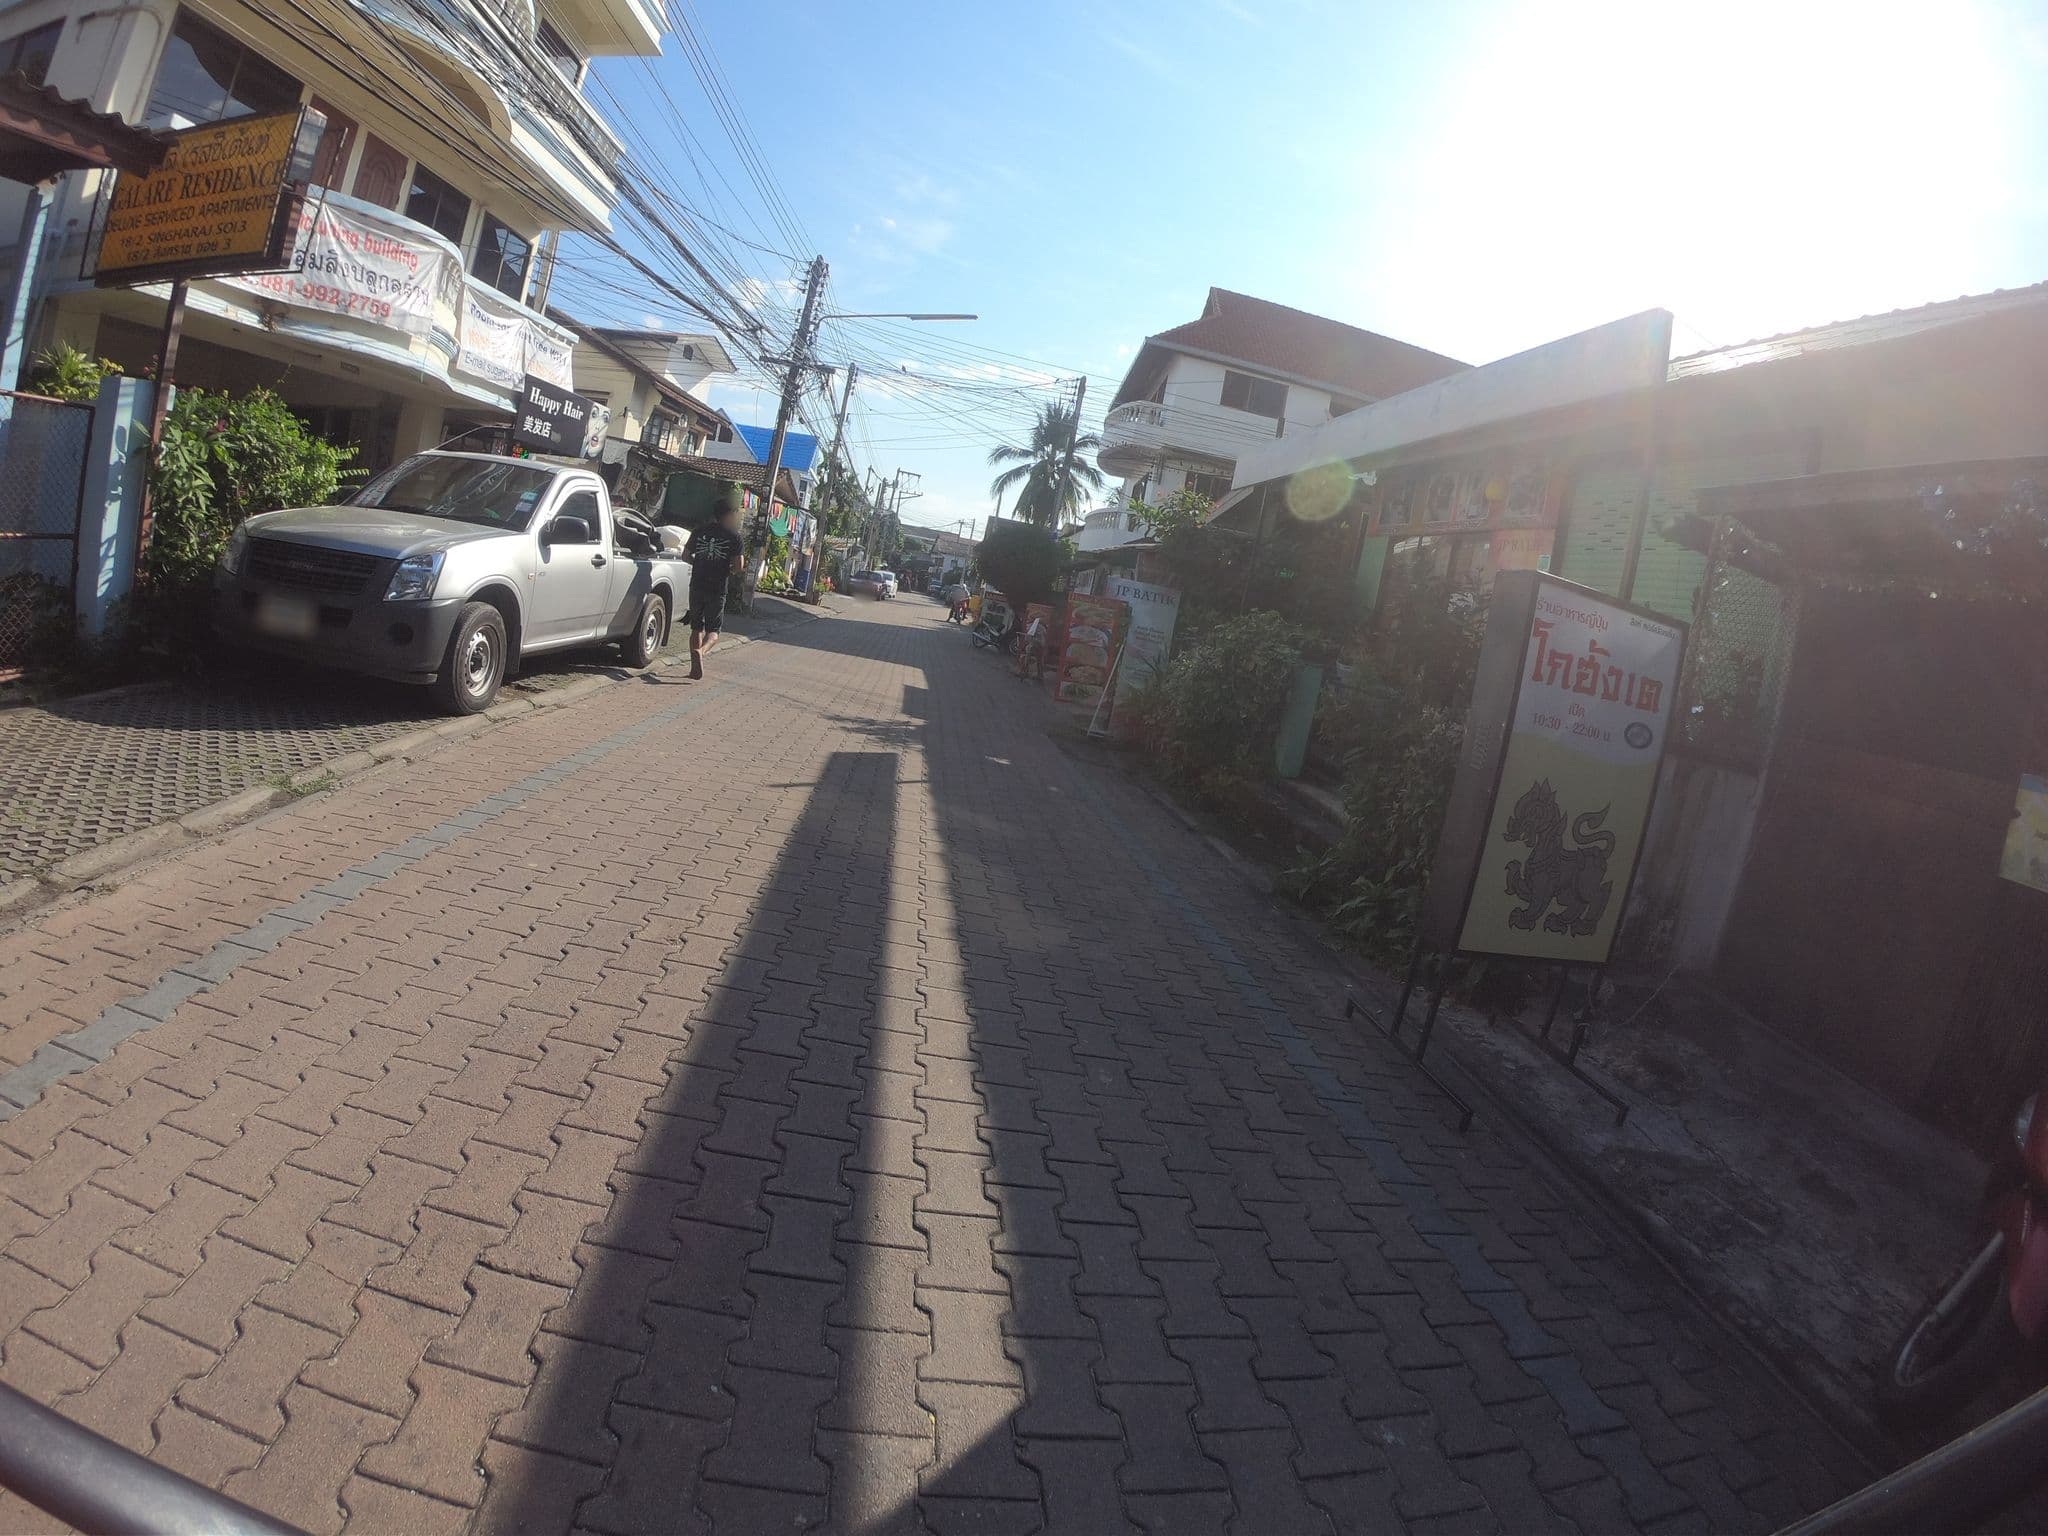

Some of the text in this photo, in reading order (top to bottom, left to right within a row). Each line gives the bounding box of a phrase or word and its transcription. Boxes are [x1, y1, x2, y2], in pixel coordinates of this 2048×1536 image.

[198, 193, 277, 217] APARTMENTS
[223, 238, 232, 250] 3
[364, 231, 419, 272] building
[529, 386, 584, 421] Happy Hair
[523, 415, 553, 439] 美发店
[1532, 712, 1562, 730] 10:30
[1571, 722, 1601, 742] 22:00
